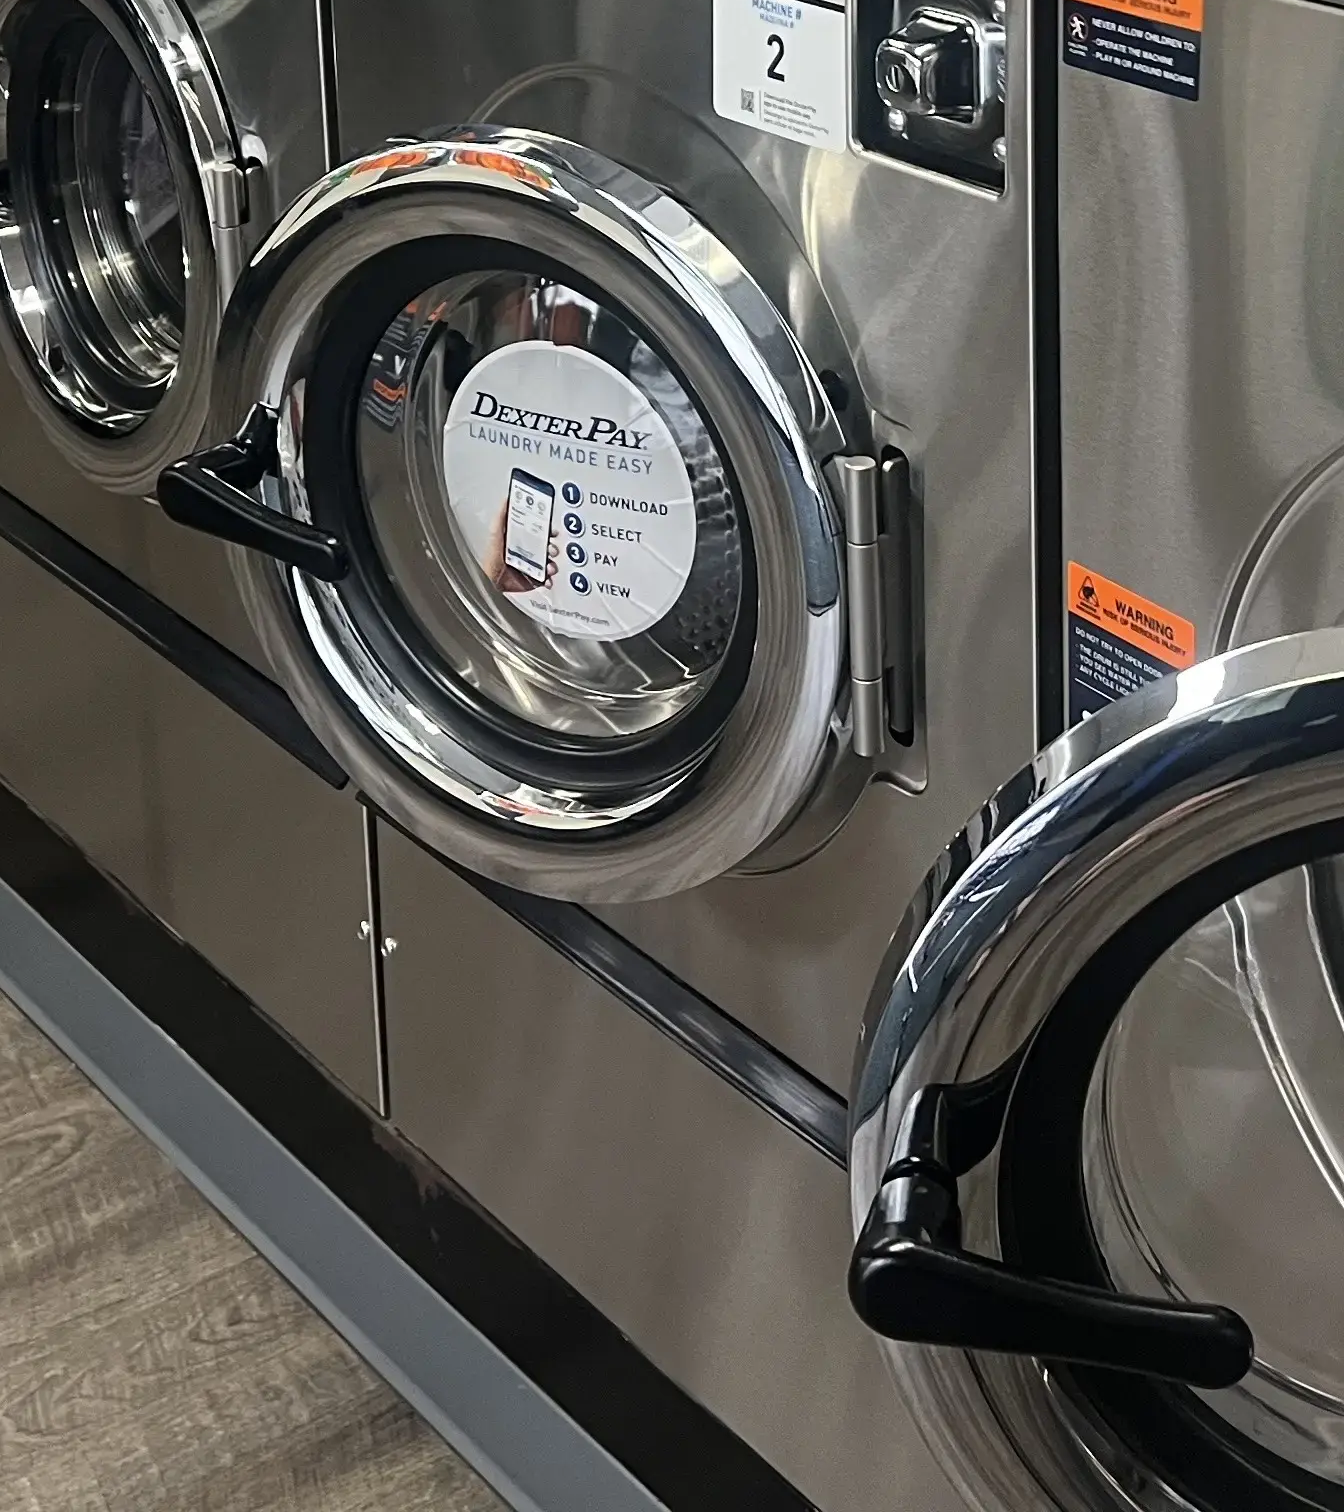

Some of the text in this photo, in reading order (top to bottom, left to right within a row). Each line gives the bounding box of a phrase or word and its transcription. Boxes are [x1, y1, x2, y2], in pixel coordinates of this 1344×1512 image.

[1092, 17, 1116, 31] NEVER
[1117, 25, 1144, 38] ALLOW
[1144, 31, 1182, 49] CHILDREN
[766, 33, 785, 82] 2
[470, 391, 653, 450] DEXTERPAY
[469, 423, 653, 475] LAUNDRY MADE EASY
[566, 486, 668, 517] 1 DOWNLOAD
[567, 517, 642, 543] 2 SELECT
[569, 546, 618, 568] 3 PAY
[573, 576, 631, 598] 4 VIEW
[1114, 598, 1174, 641] WARNING
